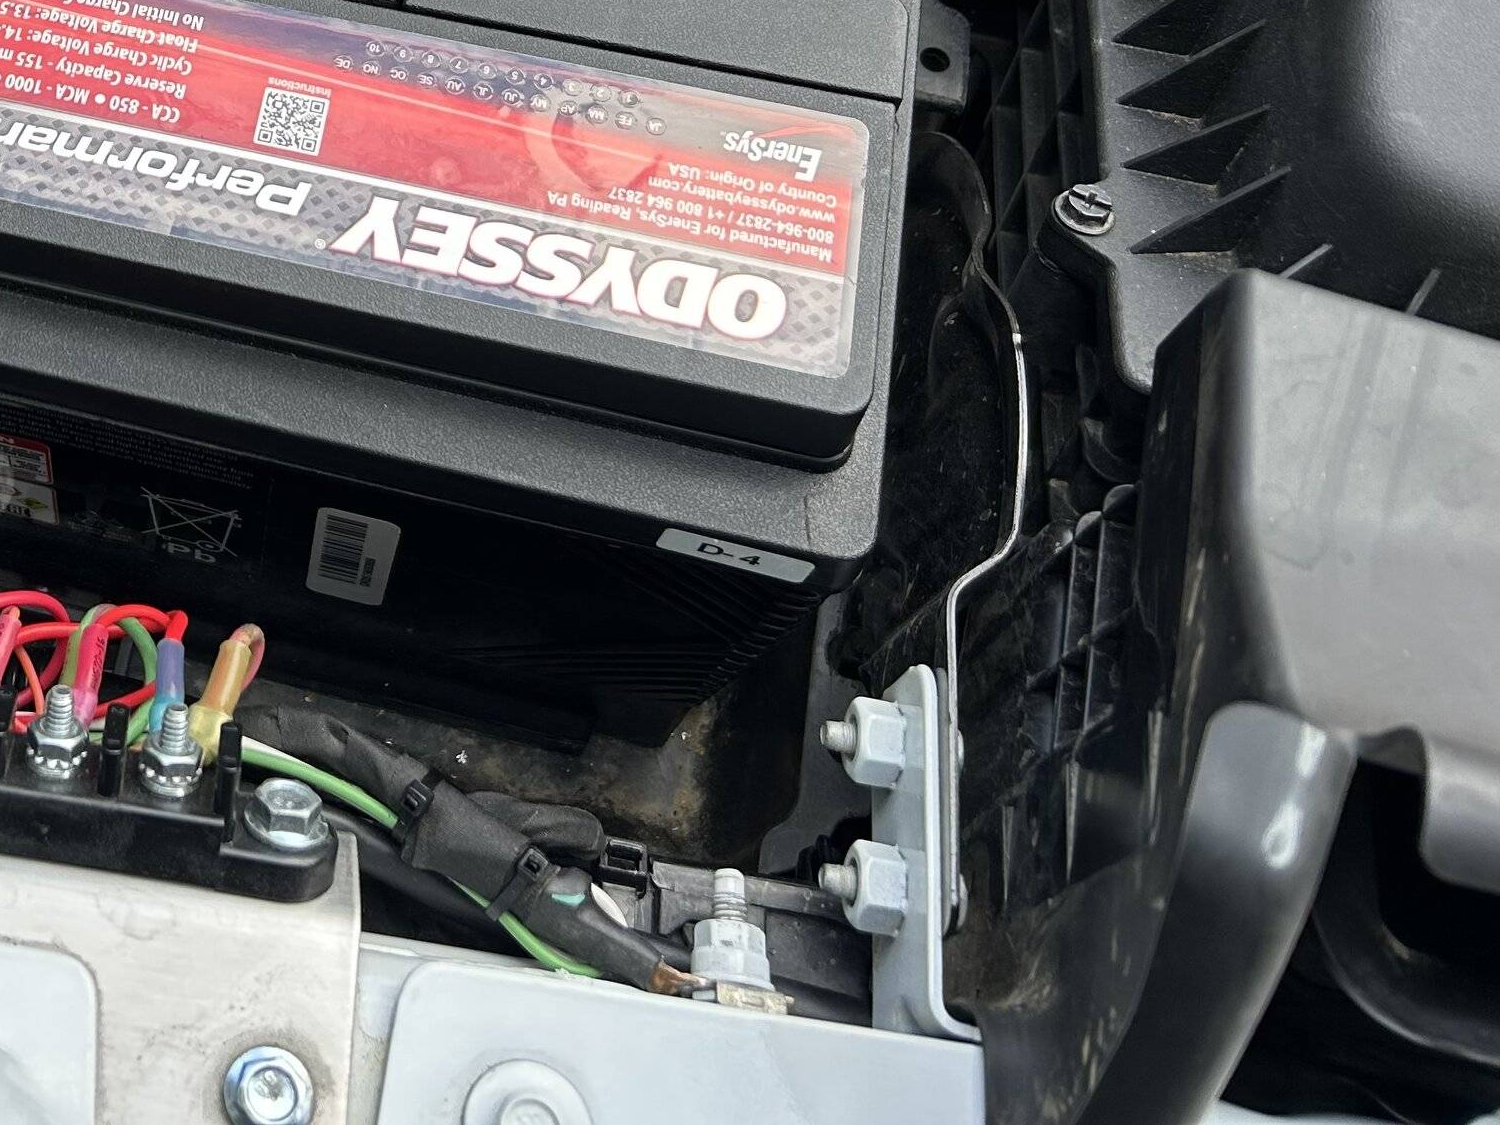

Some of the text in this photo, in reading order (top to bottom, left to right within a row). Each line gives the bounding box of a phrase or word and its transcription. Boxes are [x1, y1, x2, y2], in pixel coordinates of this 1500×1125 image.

[34, 3, 100, 33] Voltage:
[131, 2, 180, 26] Initial
[180, 12, 204, 30] No
[26, 25, 92, 55] Voltage:
[99, 16, 157, 44] Charge
[156, 30, 199, 53] Float
[14, 50, 45, 70] 155
[92, 39, 148, 67] Charge
[148, 50, 193, 76] Cyclic
[54, 55, 123, 86] Capacity
[3, 72, 43, 95] 1000
[52, 82, 90, 105] MCA
[122, 72, 186, 99] Reserve
[266, 75, 331, 98] Instructions
[108, 93, 140, 115] 850
[149, 102, 181, 124] CCA
[720, 125, 822, 183] EnerSys
[607, 184, 643, 204] 2837
[666, 161, 837, 208] Country of Origin: USA
[646, 172, 836, 225] www.odysseybattery.com
[646, 192, 673, 210] 964
[676, 198, 703, 216] 800
[545, 189, 832, 261] Manufactured for EnerSys, Reading PA
[706, 204, 725, 221] +1
[736, 211, 834, 243] 800-964-2837
[327, 187, 791, 348] ODYSSEY
[696, 541, 761, 566] D-4
